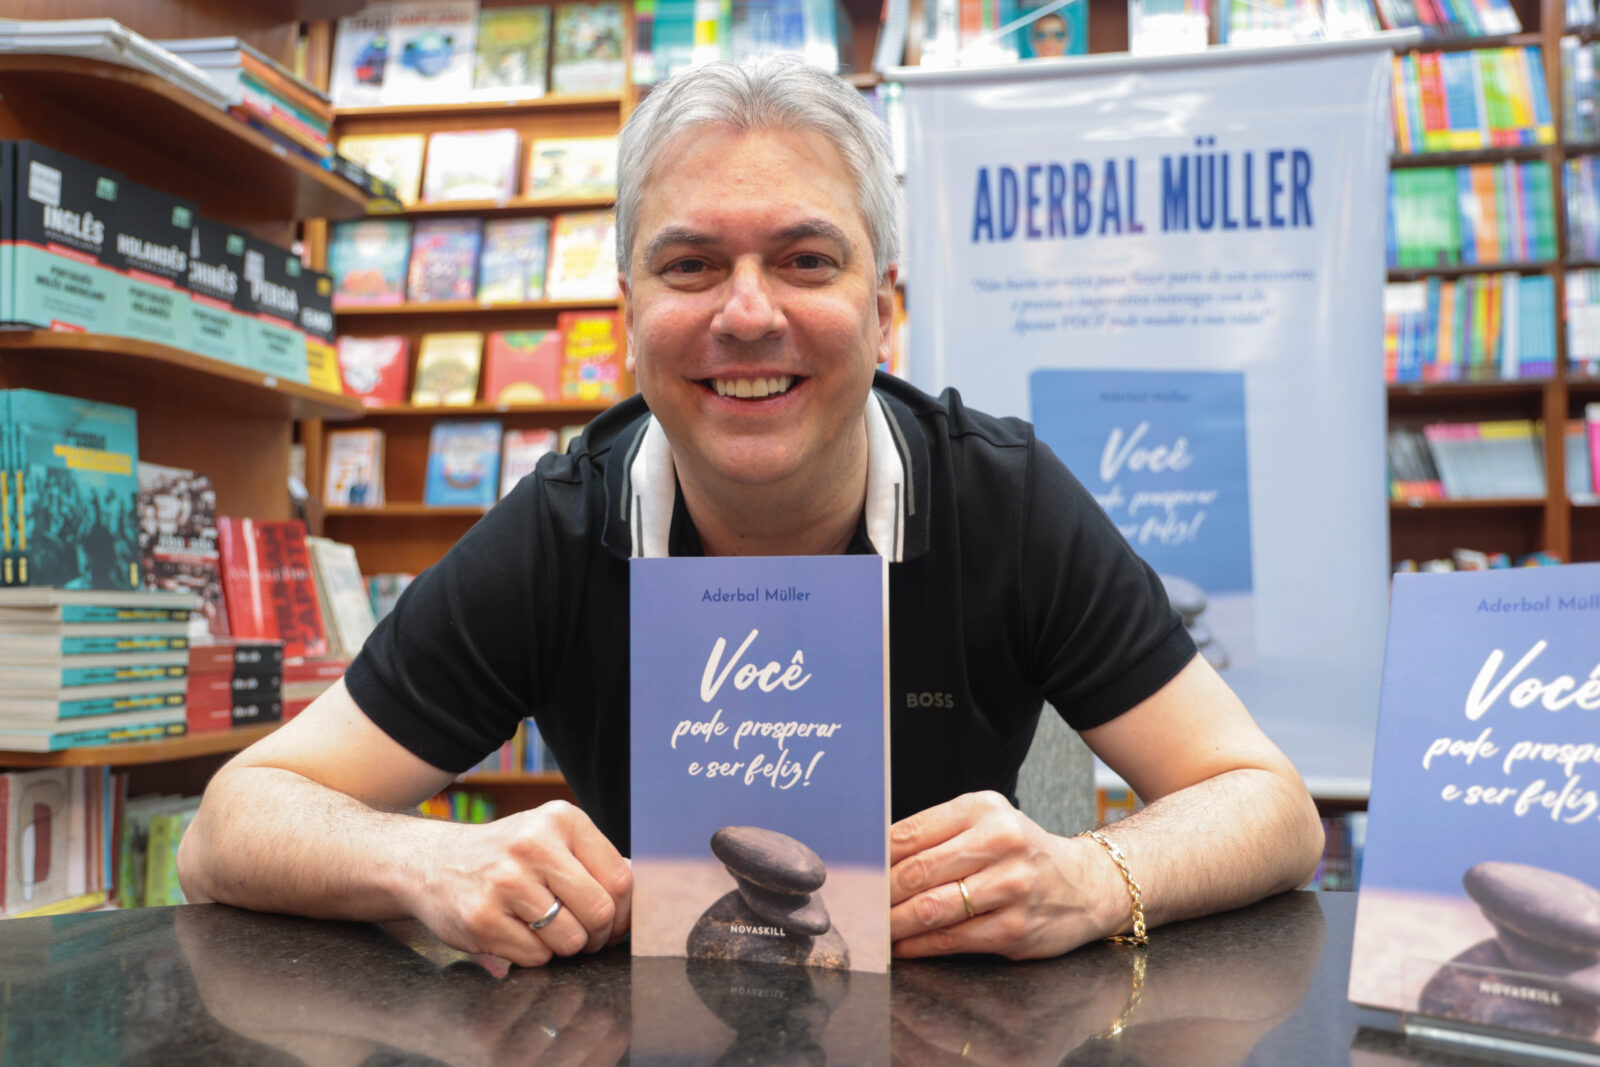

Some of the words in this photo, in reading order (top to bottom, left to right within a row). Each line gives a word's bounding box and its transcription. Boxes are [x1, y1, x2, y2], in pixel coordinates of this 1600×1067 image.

[971, 160, 1145, 243] ADERBAL
[1160, 136, 1314, 233] MÜLLER
[44, 205, 105, 245] INGLÊS
[1100, 420, 1194, 484] Você
[702, 588, 759, 602] Aderbal
[765, 587, 811, 602] Müller
[1476, 596, 1551, 613] Aderbal
[700, 628, 812, 703] Você
[1464, 639, 1600, 721] Você
[906, 692, 954, 708] BOSS
[670, 708, 729, 750] pode
[733, 720, 842, 751] prosperar
[1422, 727, 1499, 770] pode
[688, 761, 704, 776] e
[705, 760, 745, 779] ser
[744, 748, 826, 790] feliz!
[1441, 784, 1463, 801] e
[1463, 785, 1518, 806] ser
[1513, 773, 1600, 824] feliz
[730, 925, 786, 937] NOVASKILL
[1479, 981, 1563, 1006] NOVASKILL
